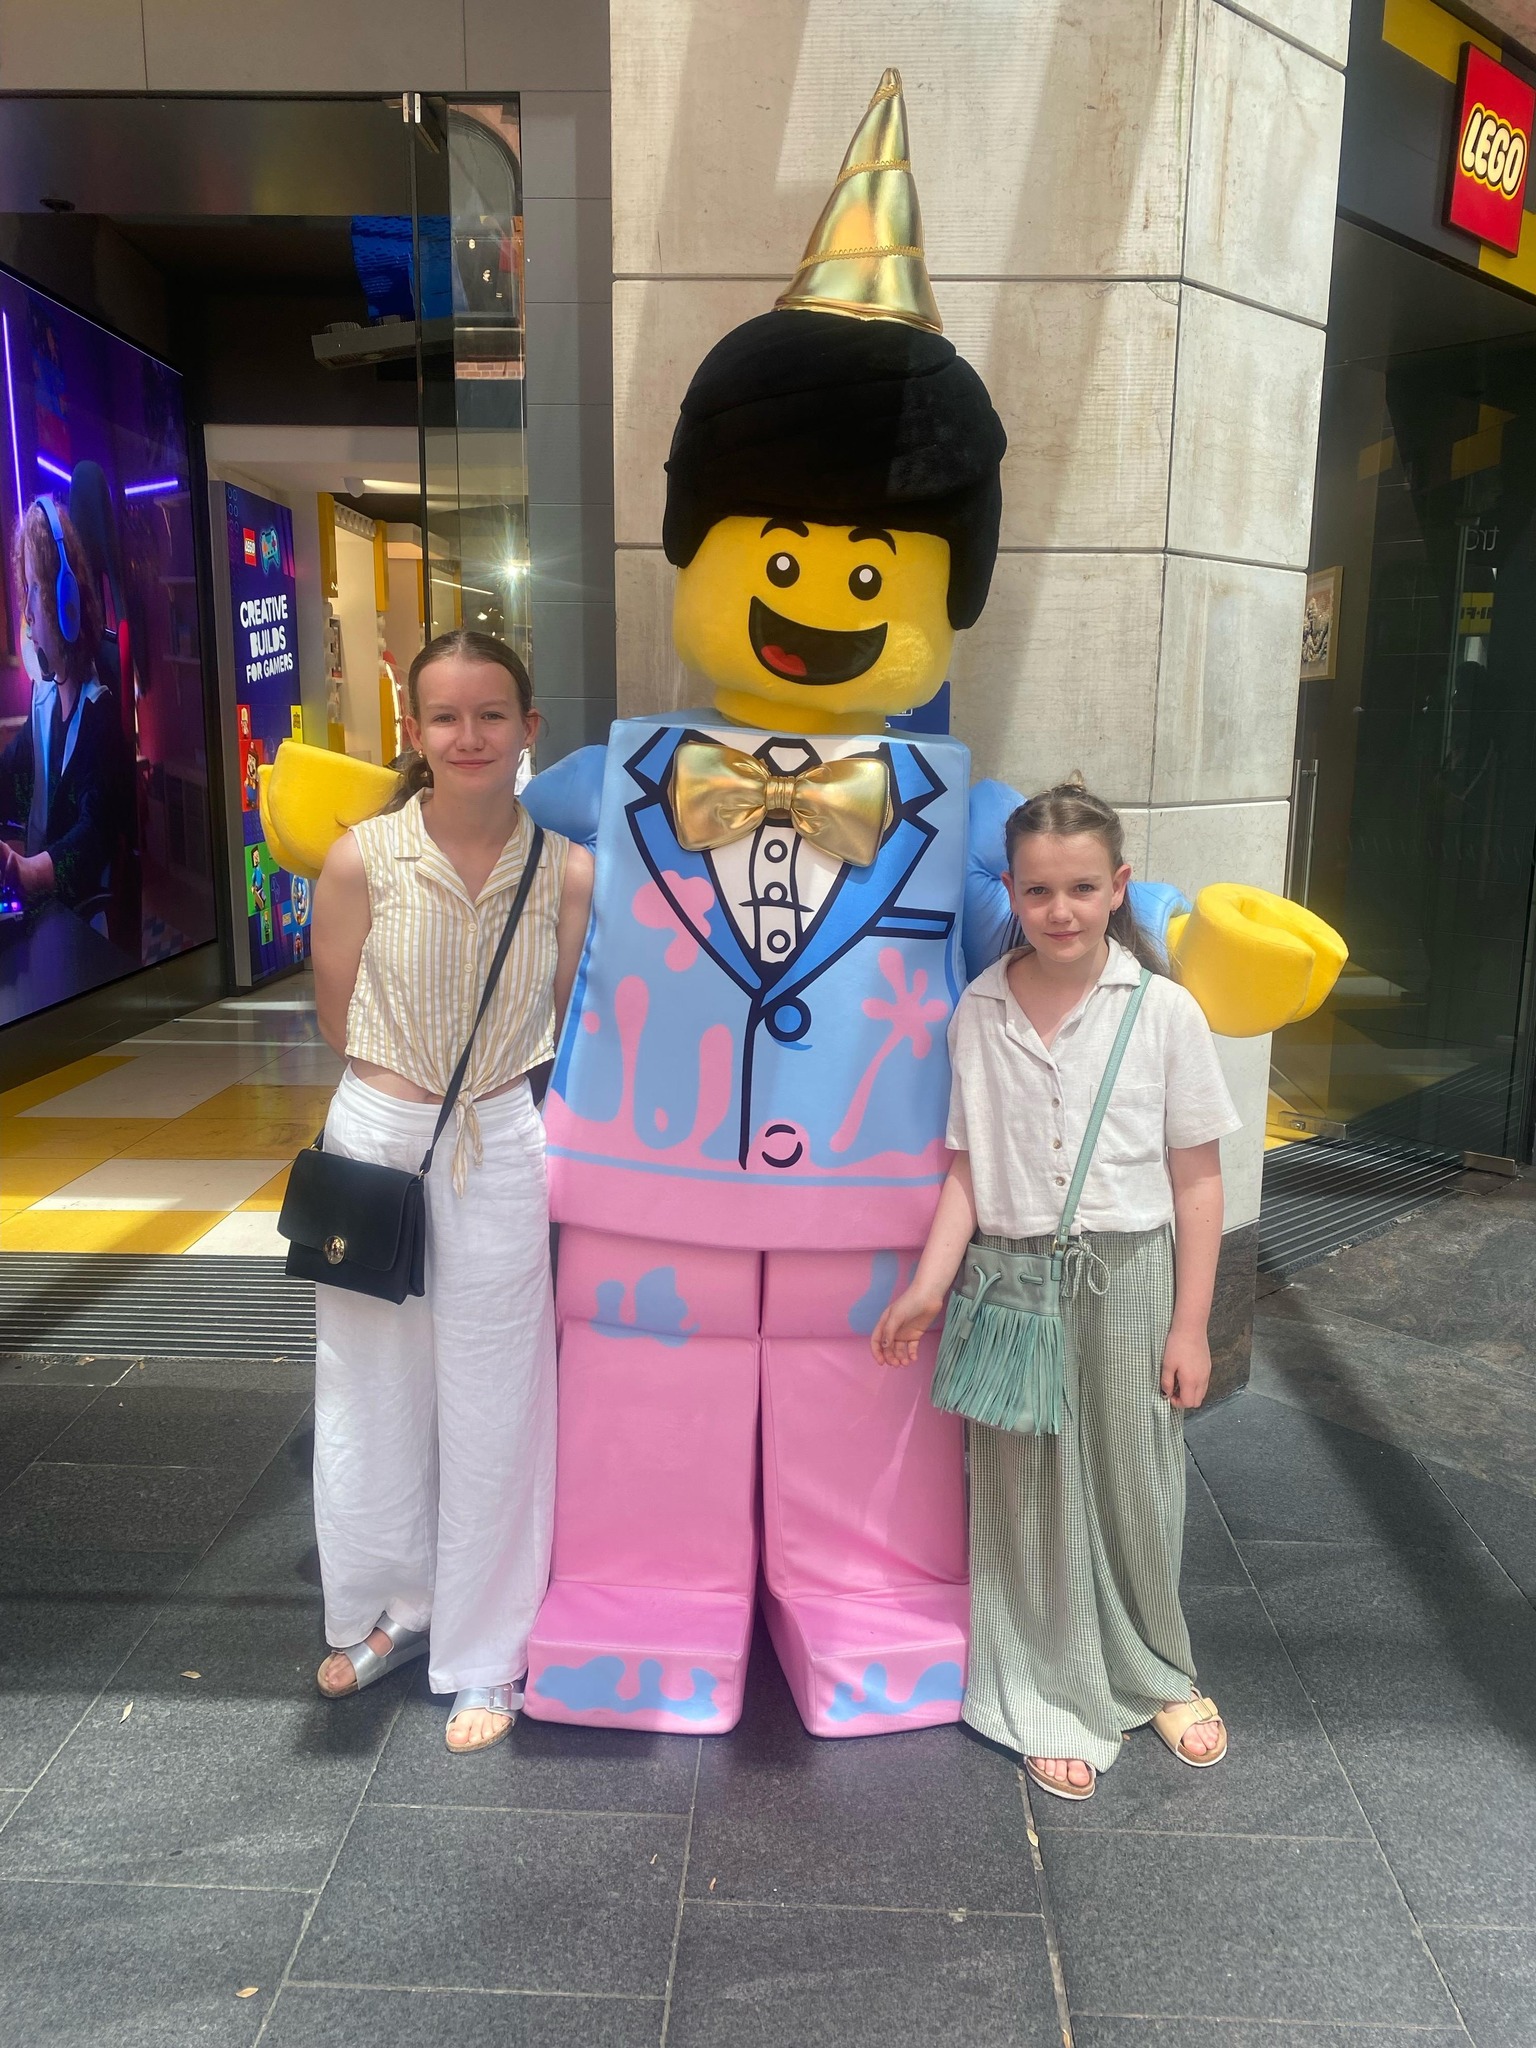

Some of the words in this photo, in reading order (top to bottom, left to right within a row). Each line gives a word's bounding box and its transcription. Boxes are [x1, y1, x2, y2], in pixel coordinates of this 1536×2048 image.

[1462, 106, 1526, 196] LEGO
[239, 594, 289, 629] CREATIVE
[249, 625, 287, 658] BUILDS
[246, 661, 263, 684] FOR
[263, 652, 294, 678] GAMERS
